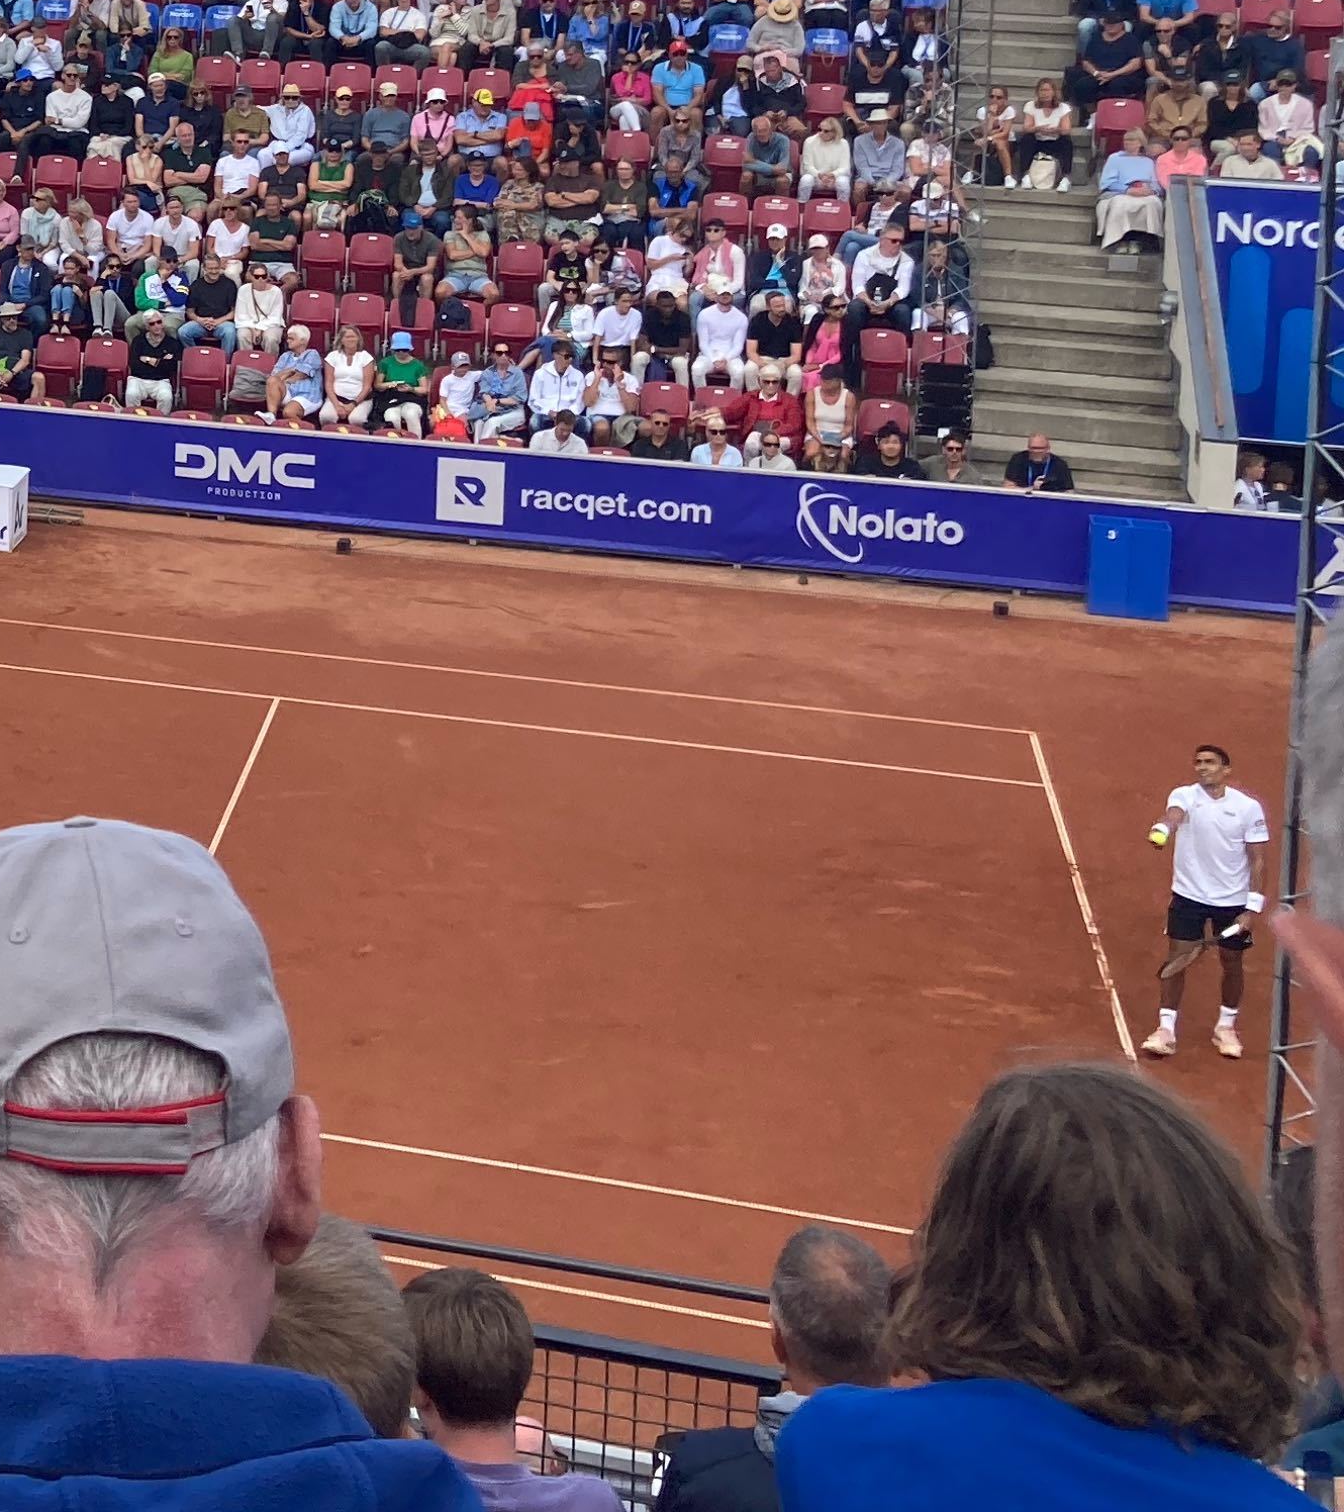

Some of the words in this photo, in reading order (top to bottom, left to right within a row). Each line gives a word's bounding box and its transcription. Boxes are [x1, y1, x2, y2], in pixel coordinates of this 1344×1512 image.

[175, 443, 315, 489] DMC
[207, 486, 281, 501] PRODUCTION
[520, 487, 712, 524] racqet.com
[828, 505, 964, 546] Nolato
